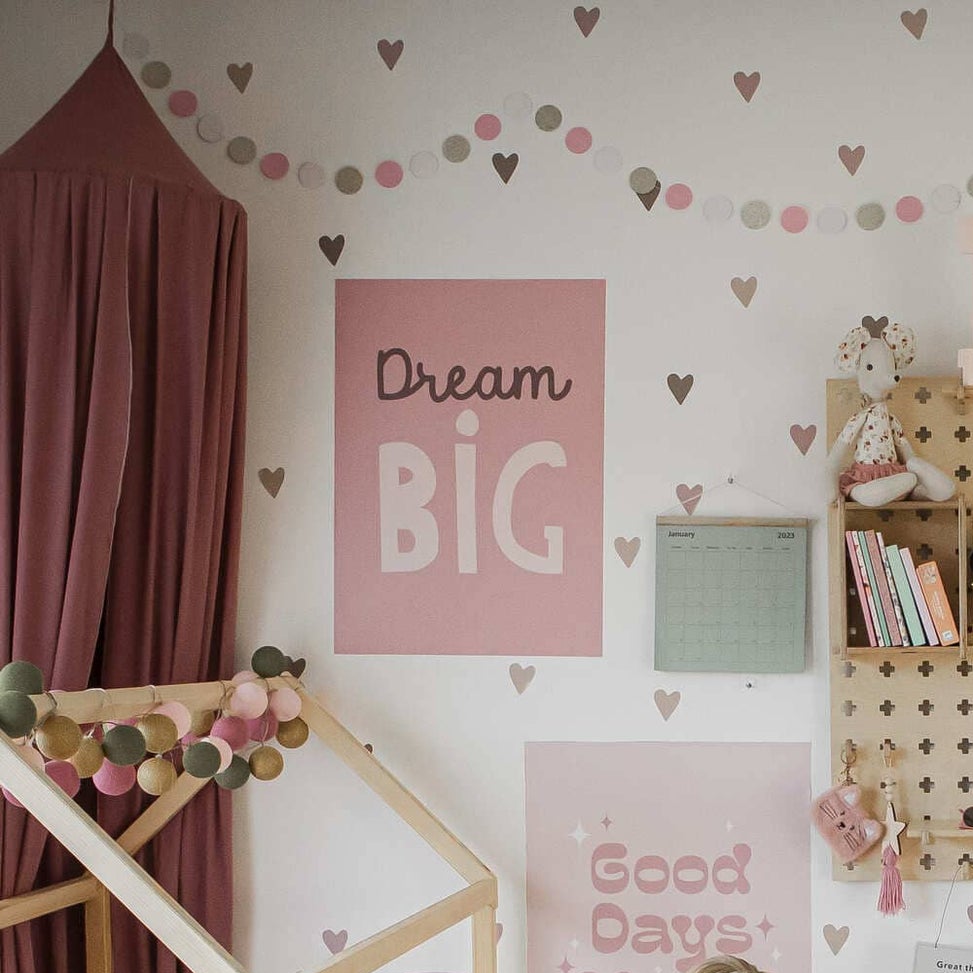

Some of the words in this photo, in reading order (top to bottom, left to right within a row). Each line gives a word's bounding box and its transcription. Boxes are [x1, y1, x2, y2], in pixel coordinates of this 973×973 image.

[376, 347, 572, 404] Dream
[668, 531, 695, 539] January
[777, 531, 795, 539] 2023
[590, 842, 752, 895] Good
[590, 901, 753, 972] Days
[936, 961, 962, 971] Great
